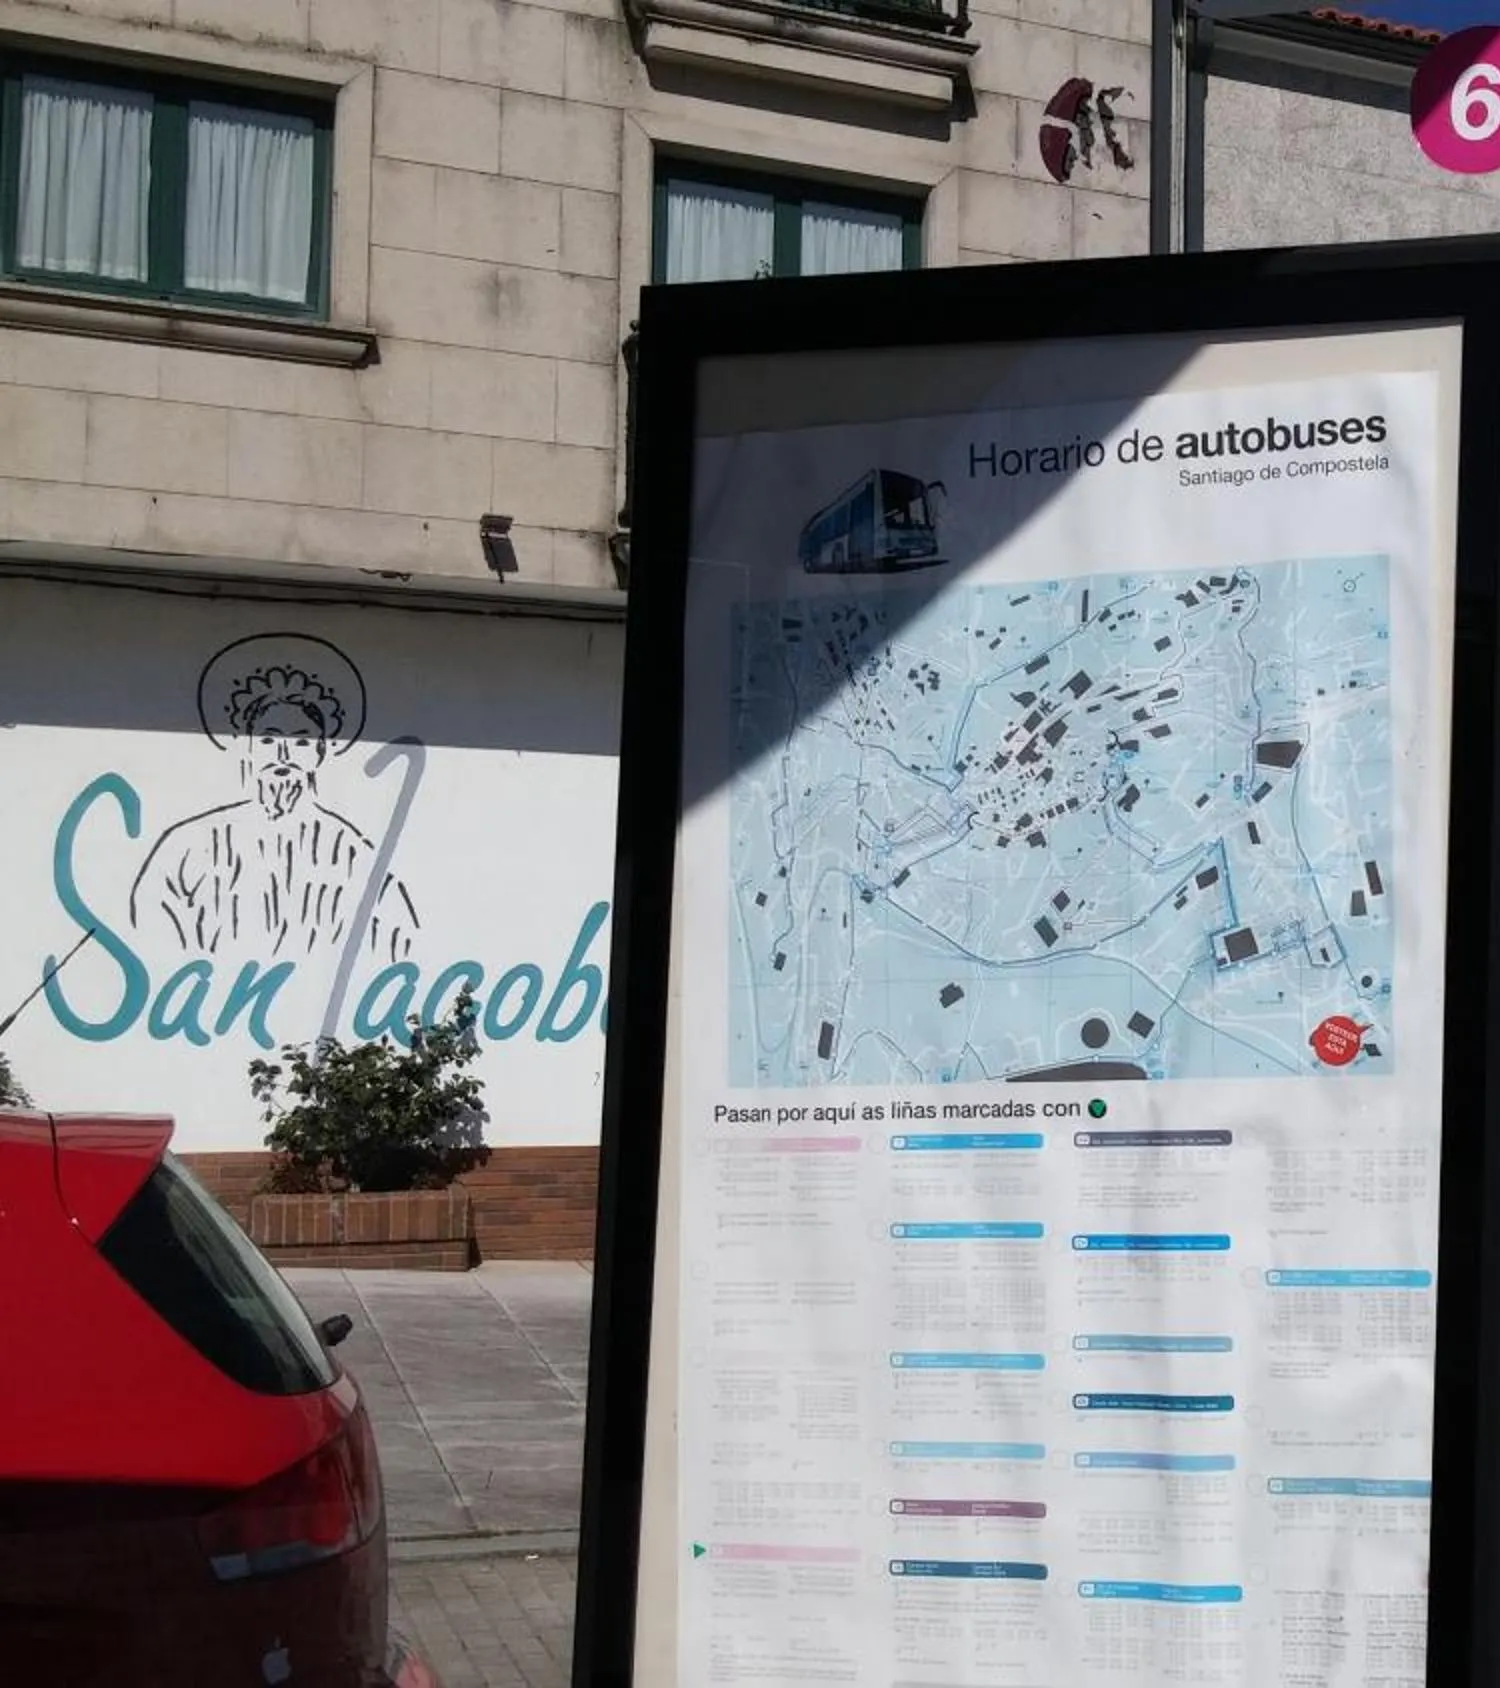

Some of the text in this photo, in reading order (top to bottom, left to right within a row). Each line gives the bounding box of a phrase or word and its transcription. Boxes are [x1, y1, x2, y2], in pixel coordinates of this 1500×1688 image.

[969, 414, 1388, 478] Horario de autobuses
[1179, 455, 1390, 487] Santiago de Compostela
[43, 773, 296, 1050] San
[714, 1099, 1081, 1125] Pasan por aquí as liñas marcadas con
